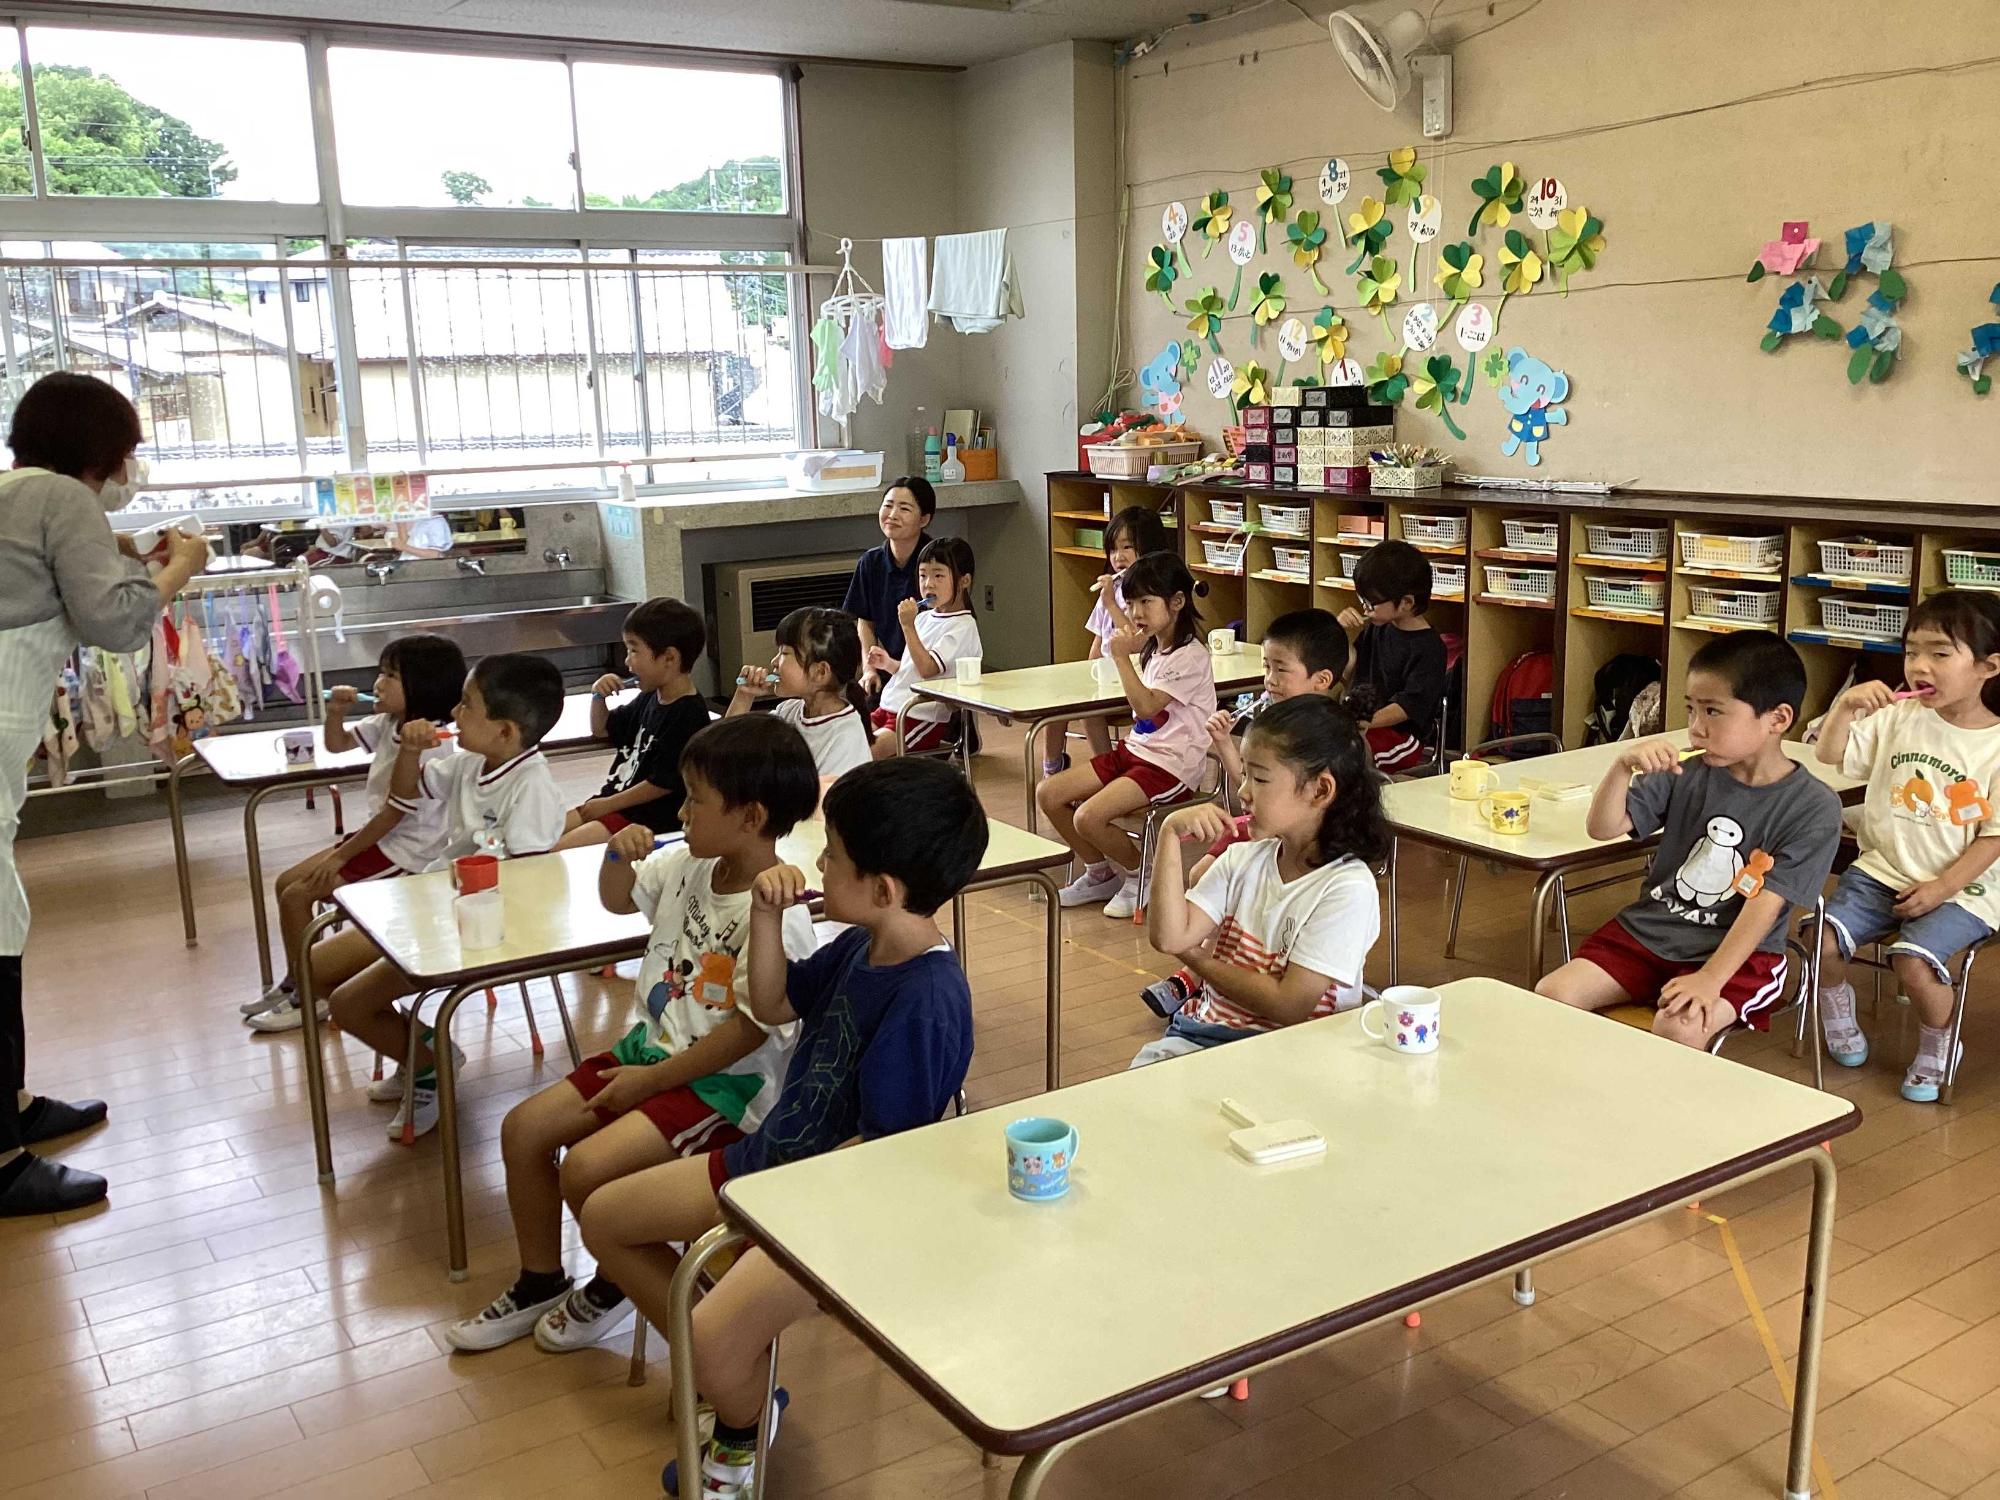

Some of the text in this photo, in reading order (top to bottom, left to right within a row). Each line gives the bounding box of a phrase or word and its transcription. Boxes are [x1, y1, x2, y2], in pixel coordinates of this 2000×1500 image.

[1328, 159, 1338, 182] 8
[1540, 178, 1557, 200] 10
[1168, 204, 1178, 225] 4
[1239, 223, 1249, 241] 5
[1471, 305, 1482, 326] 3
[1339, 358, 1348, 381] 1
[687, 895, 711, 939] Mickey
